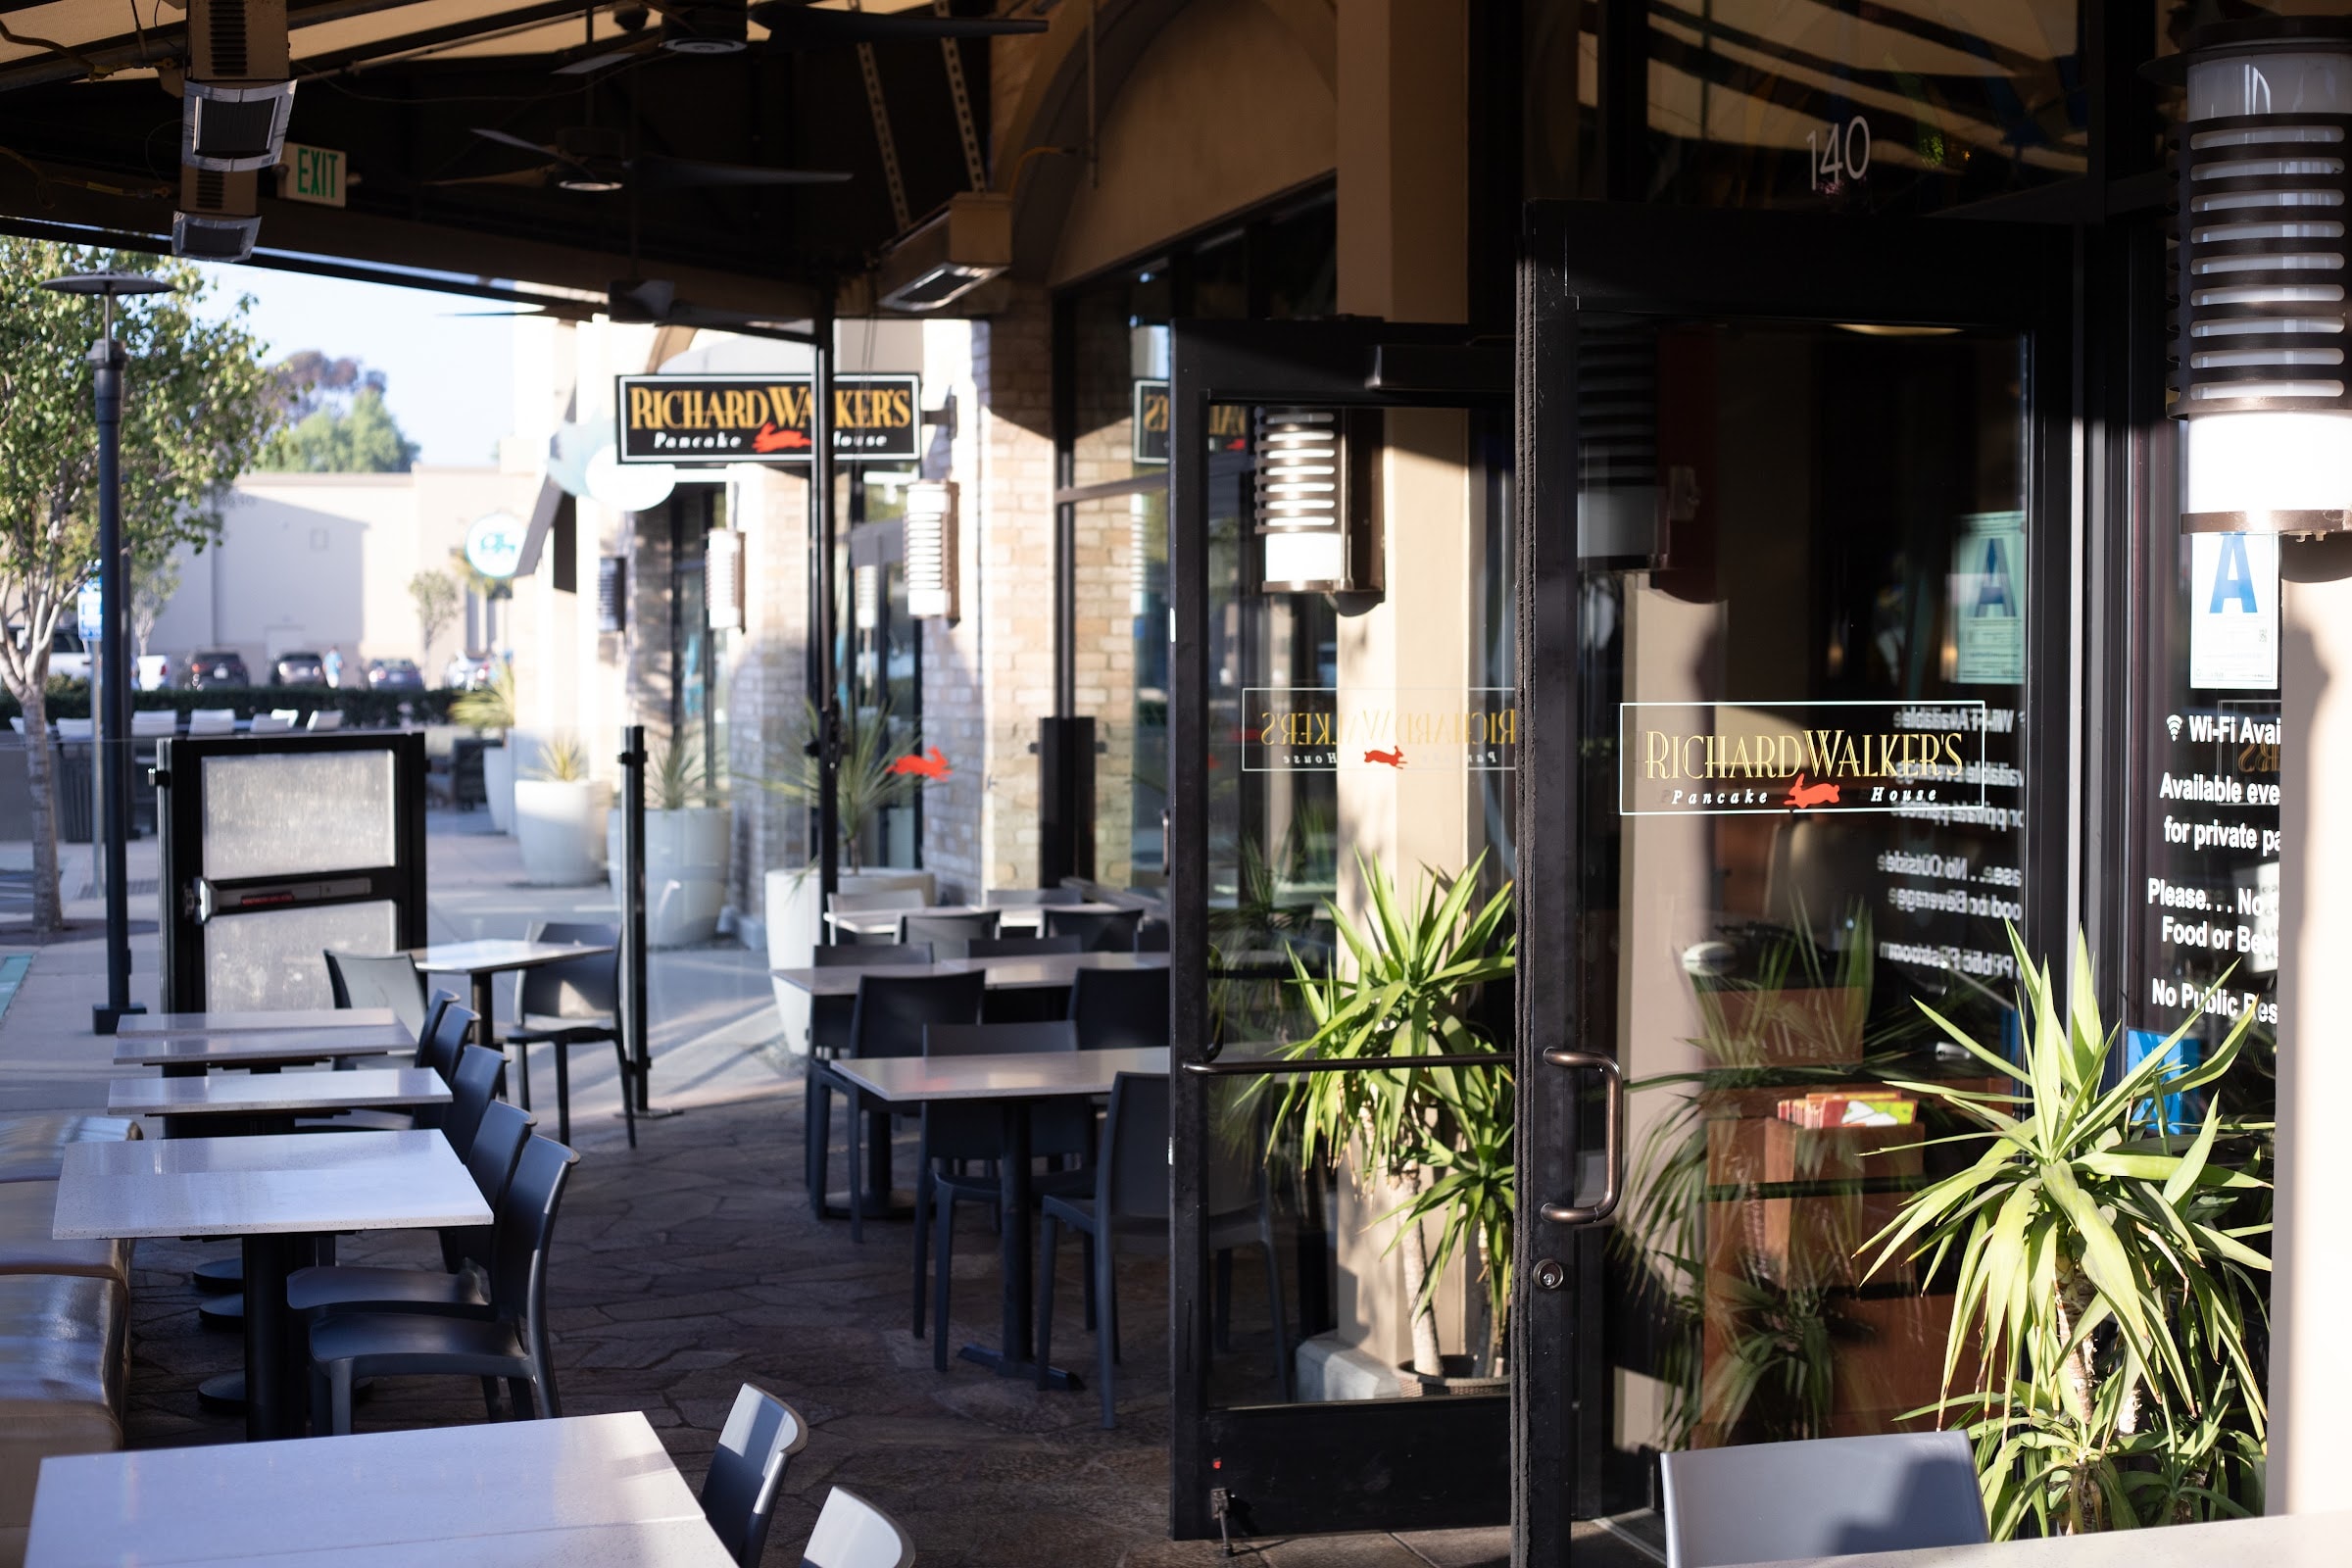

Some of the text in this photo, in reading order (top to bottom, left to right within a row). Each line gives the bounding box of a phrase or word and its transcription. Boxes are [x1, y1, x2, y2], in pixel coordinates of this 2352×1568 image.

[1806, 116, 1870, 191] 140
[298, 148, 338, 198] EXIT
[629, 386, 911, 429] RICHARD WAKER'S
[654, 431, 742, 449] Pancake
[2209, 531, 2258, 613] A
[2188, 715, 2235, 743] Wi-Fi
[1645, 729, 1964, 779] RICHARD WALKER'S
[1671, 787, 1936, 805] Pancake House
[2159, 772, 2242, 803] Available
[2164, 815, 2190, 844] for
[2194, 819, 2257, 851] private
[2238, 888, 2263, 916] No
[2162, 916, 2208, 948] Food
[2212, 929, 2232, 951] or
[2152, 978, 2177, 1006] No
[2181, 983, 2238, 1016] Public
